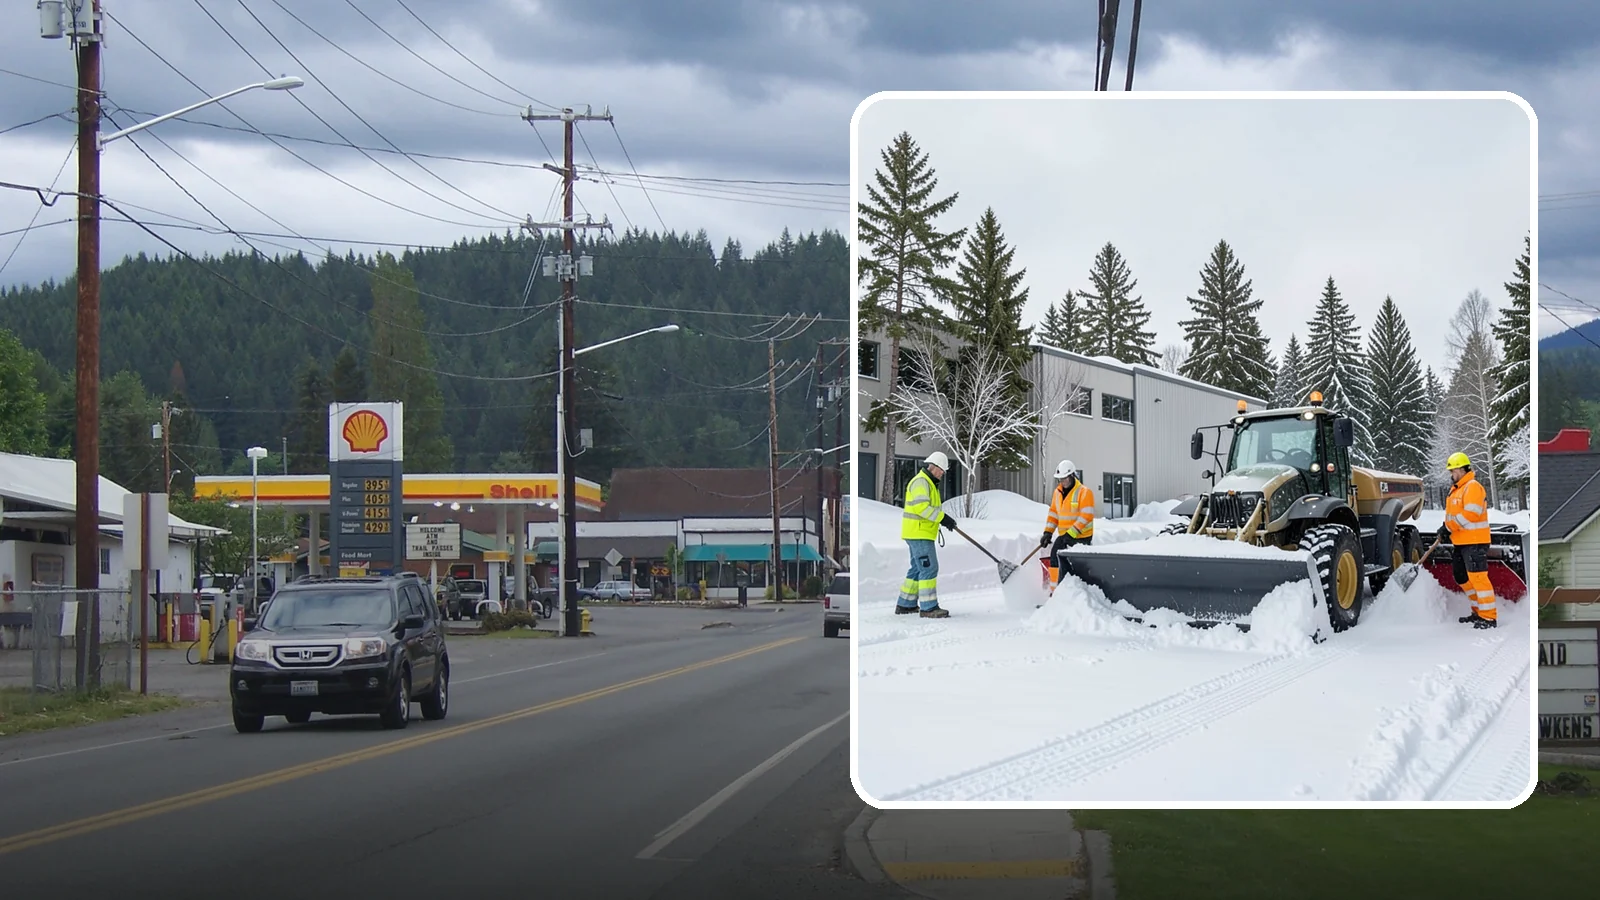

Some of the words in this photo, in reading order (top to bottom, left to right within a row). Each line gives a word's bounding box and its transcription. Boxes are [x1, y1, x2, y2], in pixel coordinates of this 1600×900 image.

[365, 480, 384, 490] 395
[490, 484, 547, 498] Shell
[365, 494, 384, 504] 405
[365, 508, 384, 518] 415
[365, 522, 384, 532] 429
